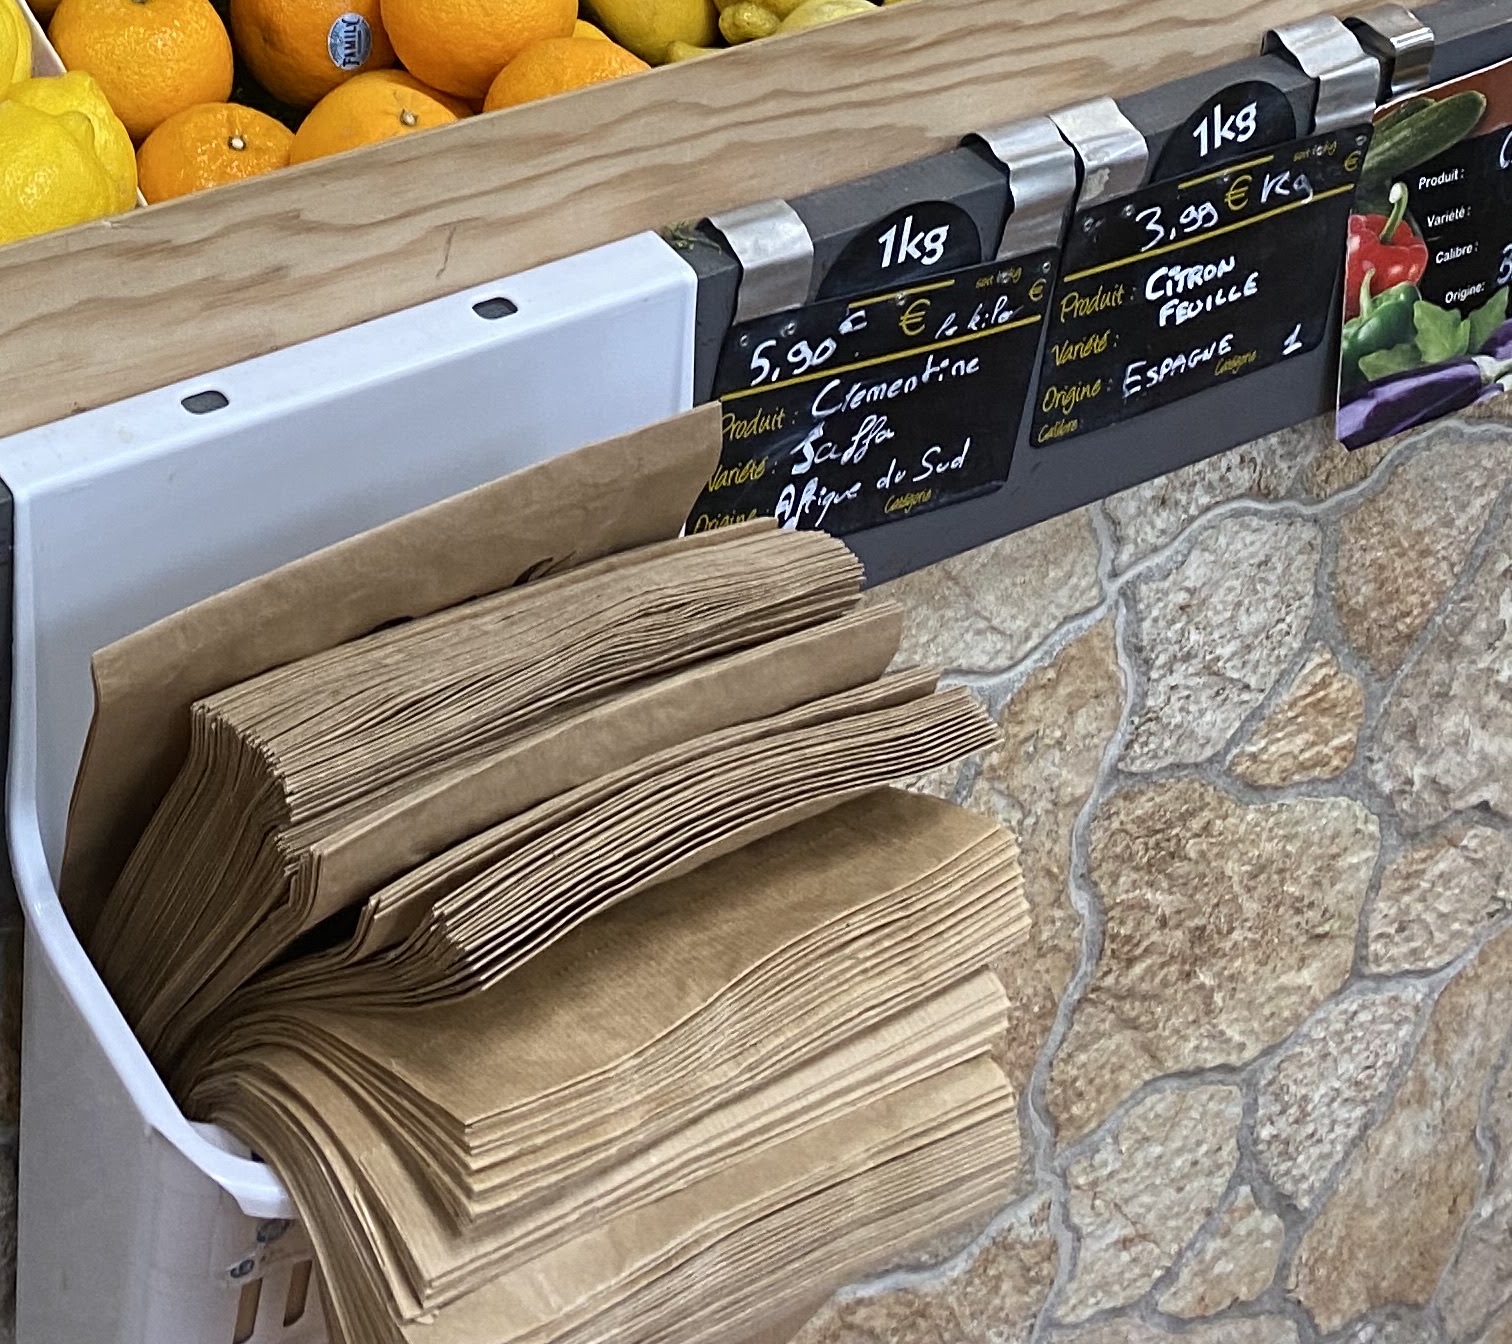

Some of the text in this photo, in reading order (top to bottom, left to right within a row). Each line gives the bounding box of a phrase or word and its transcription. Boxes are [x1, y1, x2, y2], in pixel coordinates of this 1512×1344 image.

[342, 18, 360, 68] FAMILY
[1193, 101, 1258, 158] 1kg
[1418, 168, 1459, 190] Produit
[1136, 202, 1219, 252] 3,99
[1224, 175, 1253, 211] €
[1427, 206, 1466, 228] Variété
[879, 216, 949, 268] 1kg
[1436, 242, 1474, 264] Calibre
[1060, 284, 1124, 324] Produit
[1159, 272, 1260, 328] FEUILLE
[750, 337, 837, 387] 5,90
[900, 299, 931, 336] €
[1042, 381, 1102, 414] Origine
[912, 437, 972, 483] Sud
